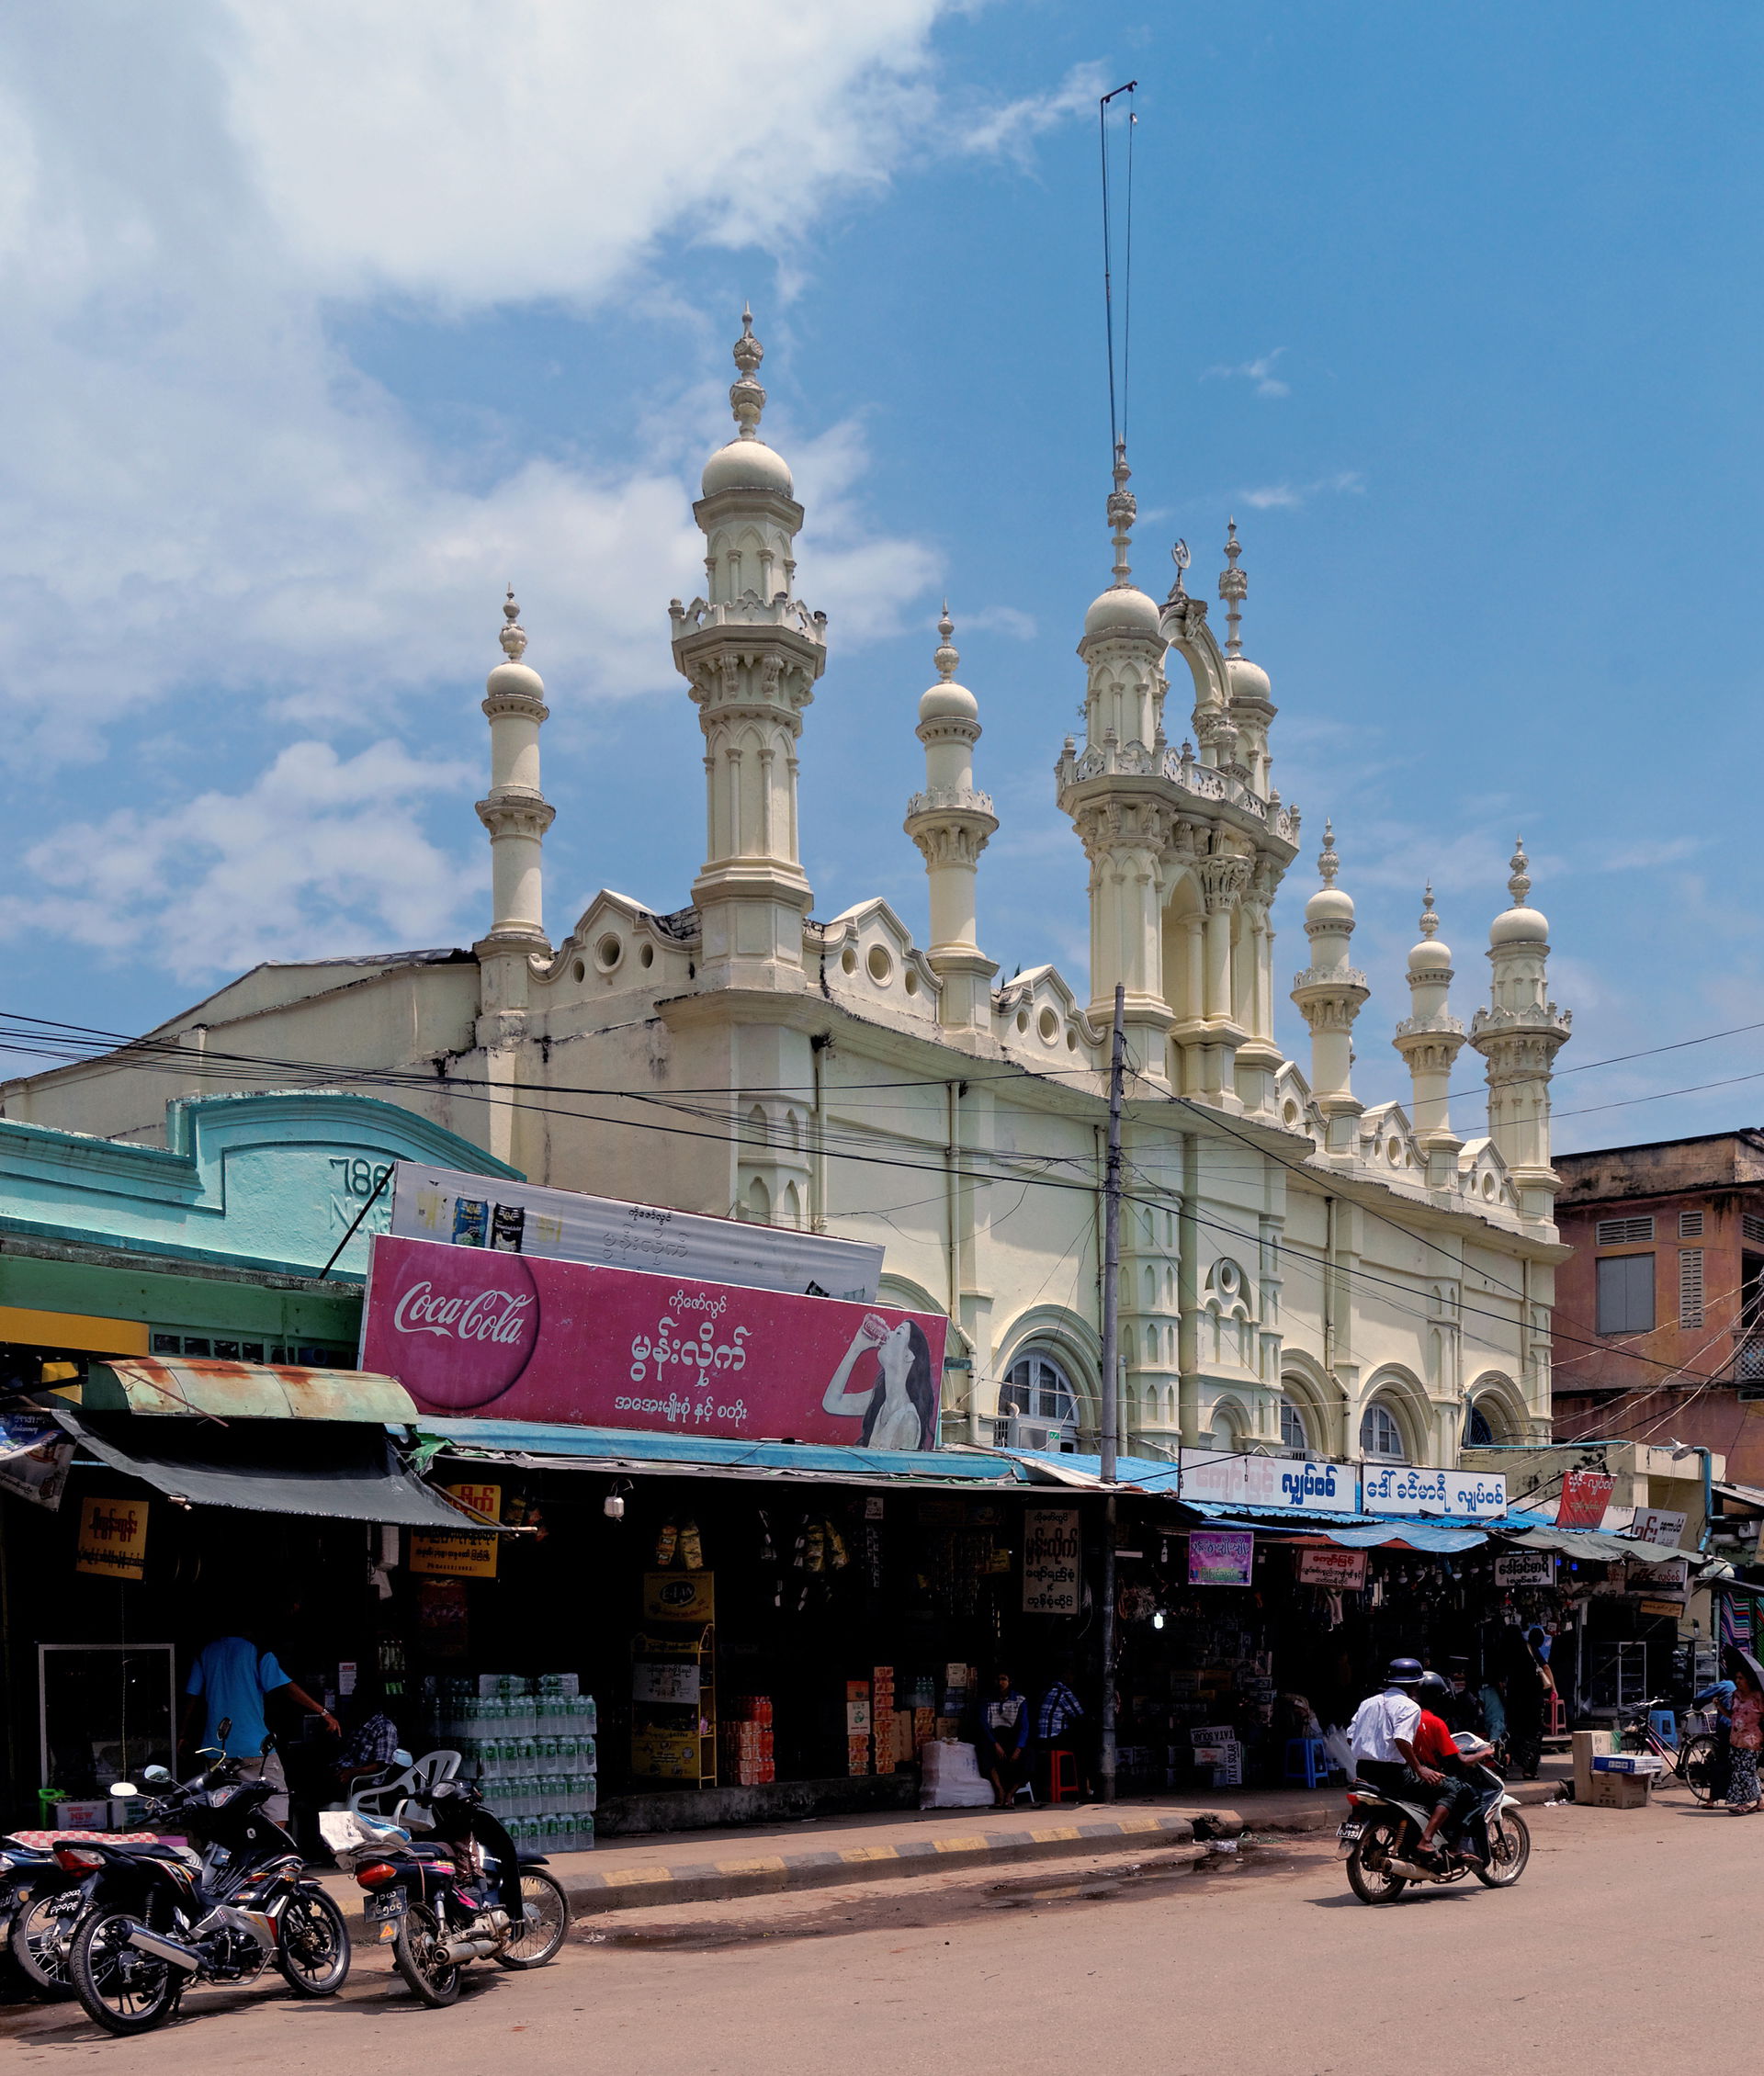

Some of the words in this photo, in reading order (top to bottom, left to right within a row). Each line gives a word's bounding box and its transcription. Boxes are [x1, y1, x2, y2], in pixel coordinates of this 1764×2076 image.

[329, 1156, 390, 1196] 786
[394, 1281, 535, 1344] Coca-Cola
[669, 1290, 727, 1319] ကိုဇော်လွင်
[615, 1393, 691, 1423] အအေးမျိုးစုံ
[694, 1396, 714, 1424] နှင့်
[717, 1399, 748, 1427] စတိုး
[1282, 1463, 1338, 1505] လျှပ်စစ်
[1458, 1482, 1504, 1513] လျှပ်စစ်
